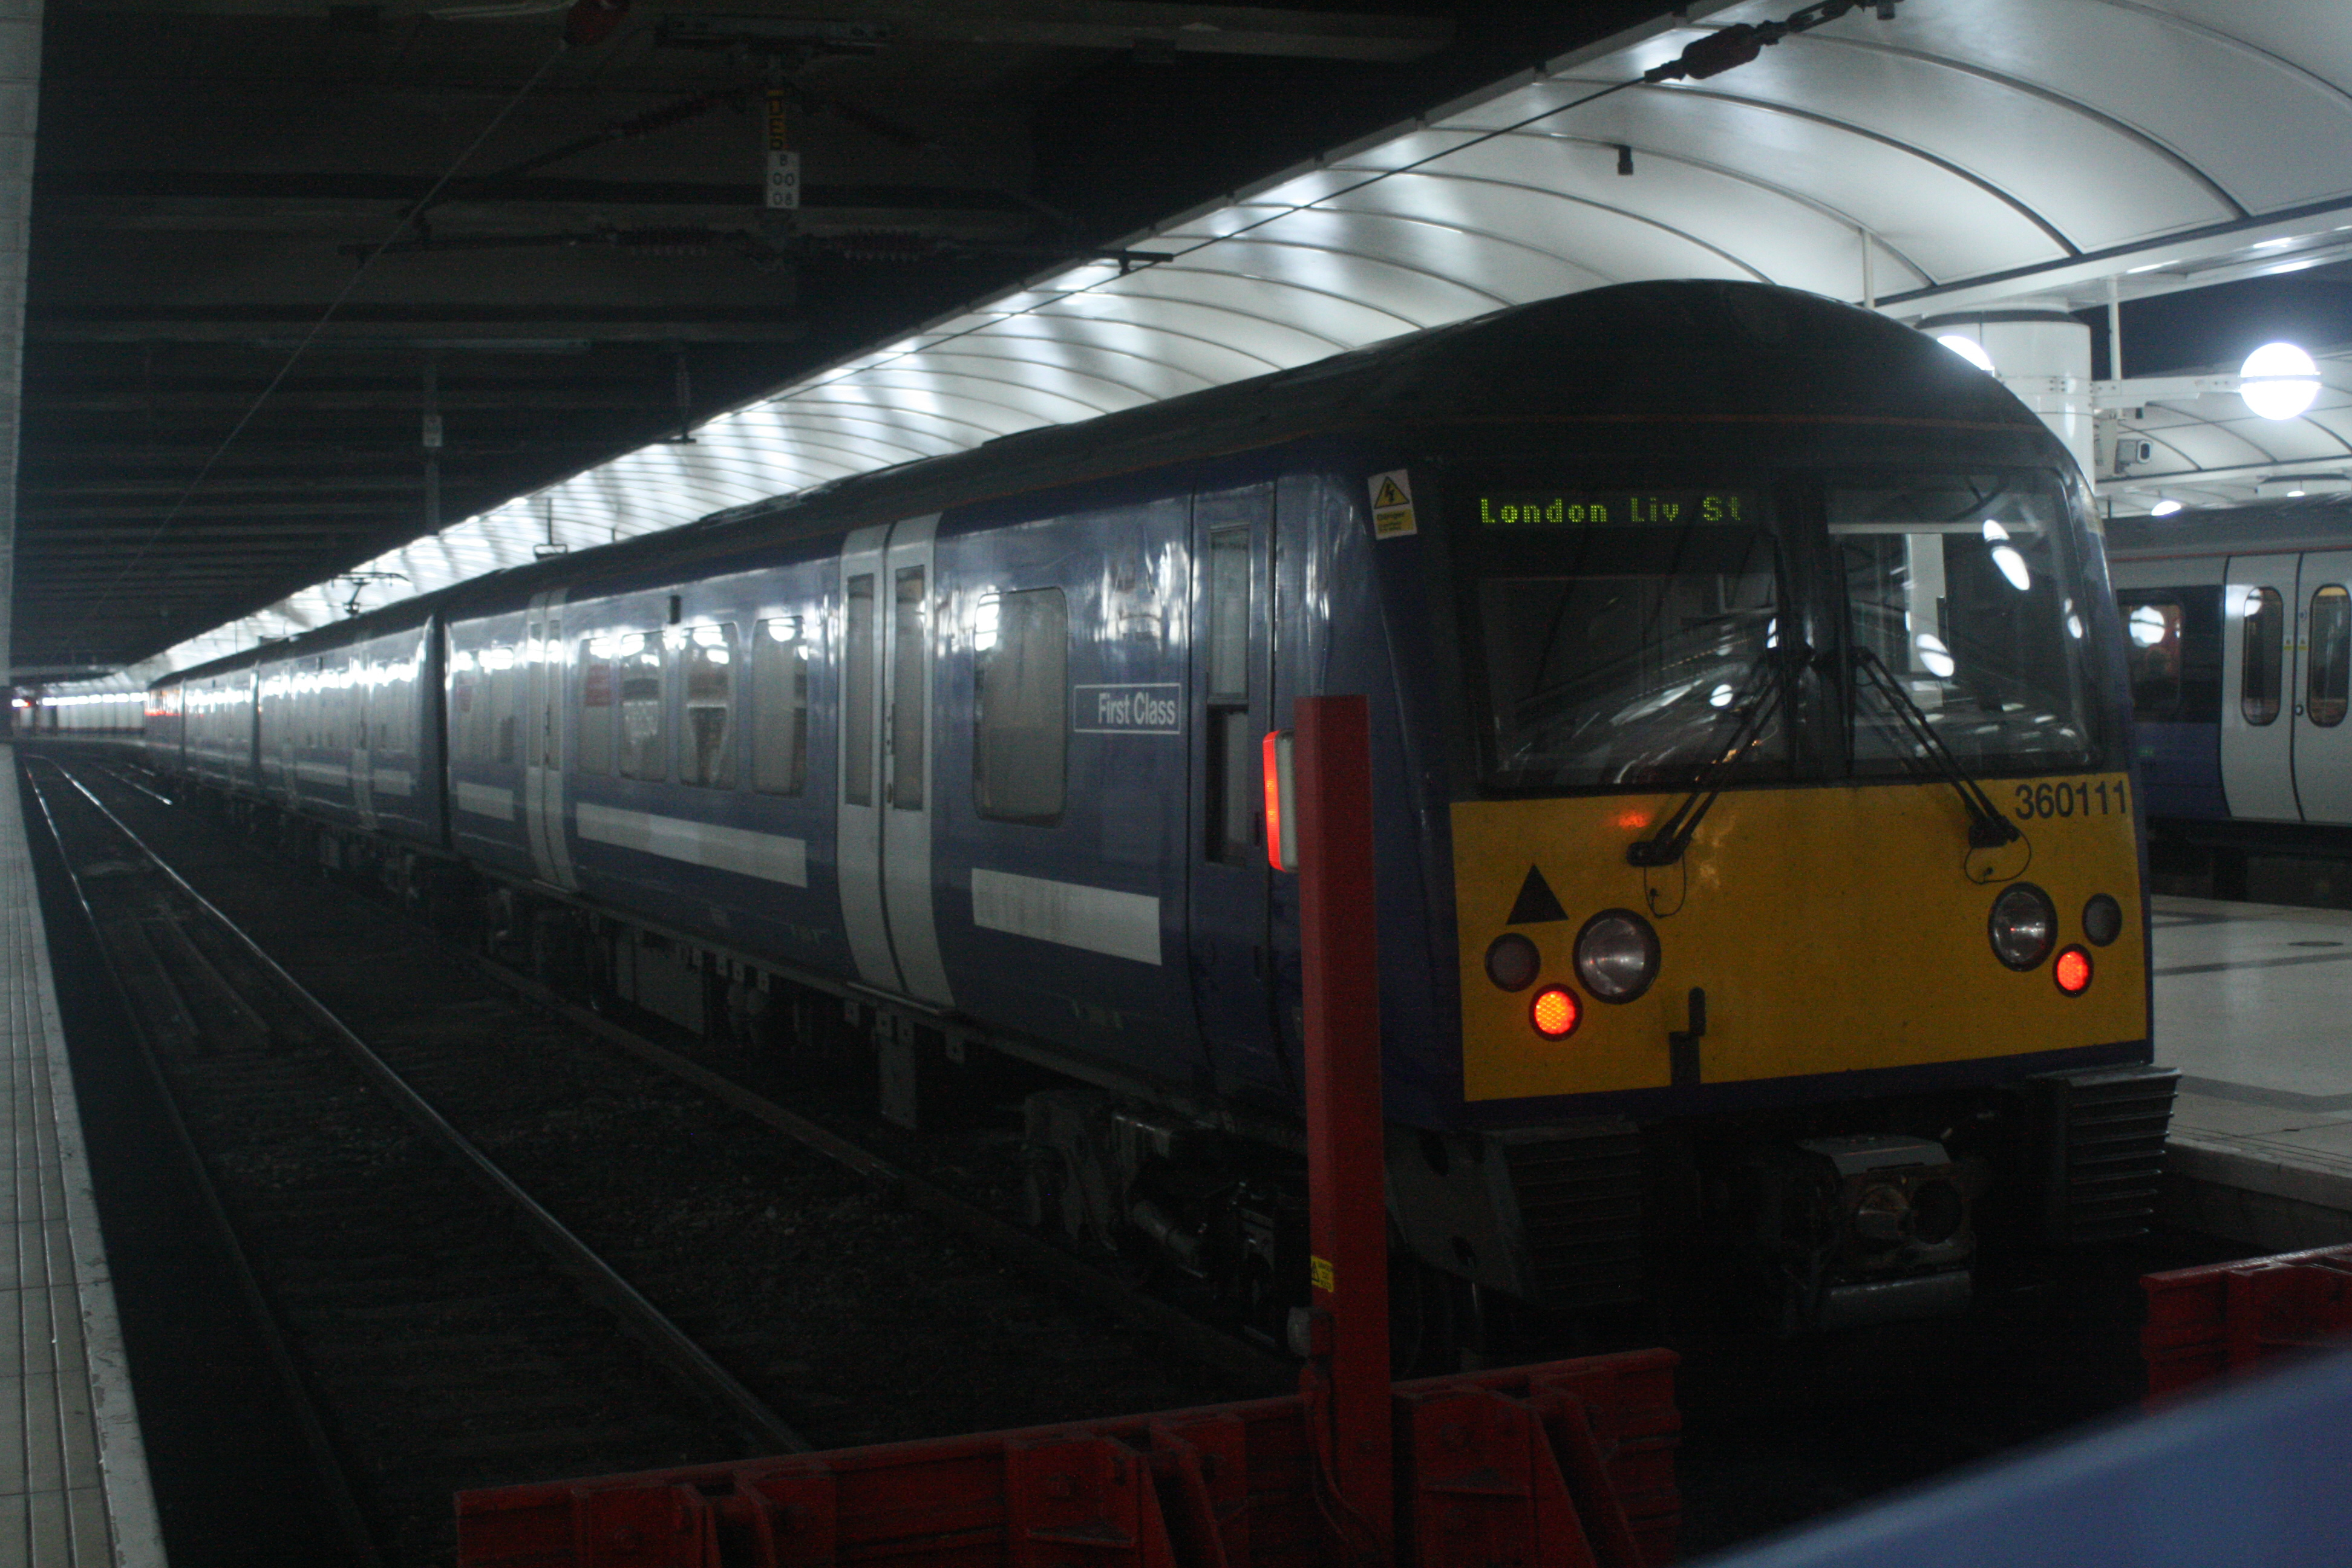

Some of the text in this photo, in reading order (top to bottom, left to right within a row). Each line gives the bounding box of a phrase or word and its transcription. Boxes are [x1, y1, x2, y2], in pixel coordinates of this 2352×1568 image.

[1480, 496, 1741, 523] London Liv St
[1098, 691, 1176, 725] First Class
[2015, 780, 2126, 820] 360111
